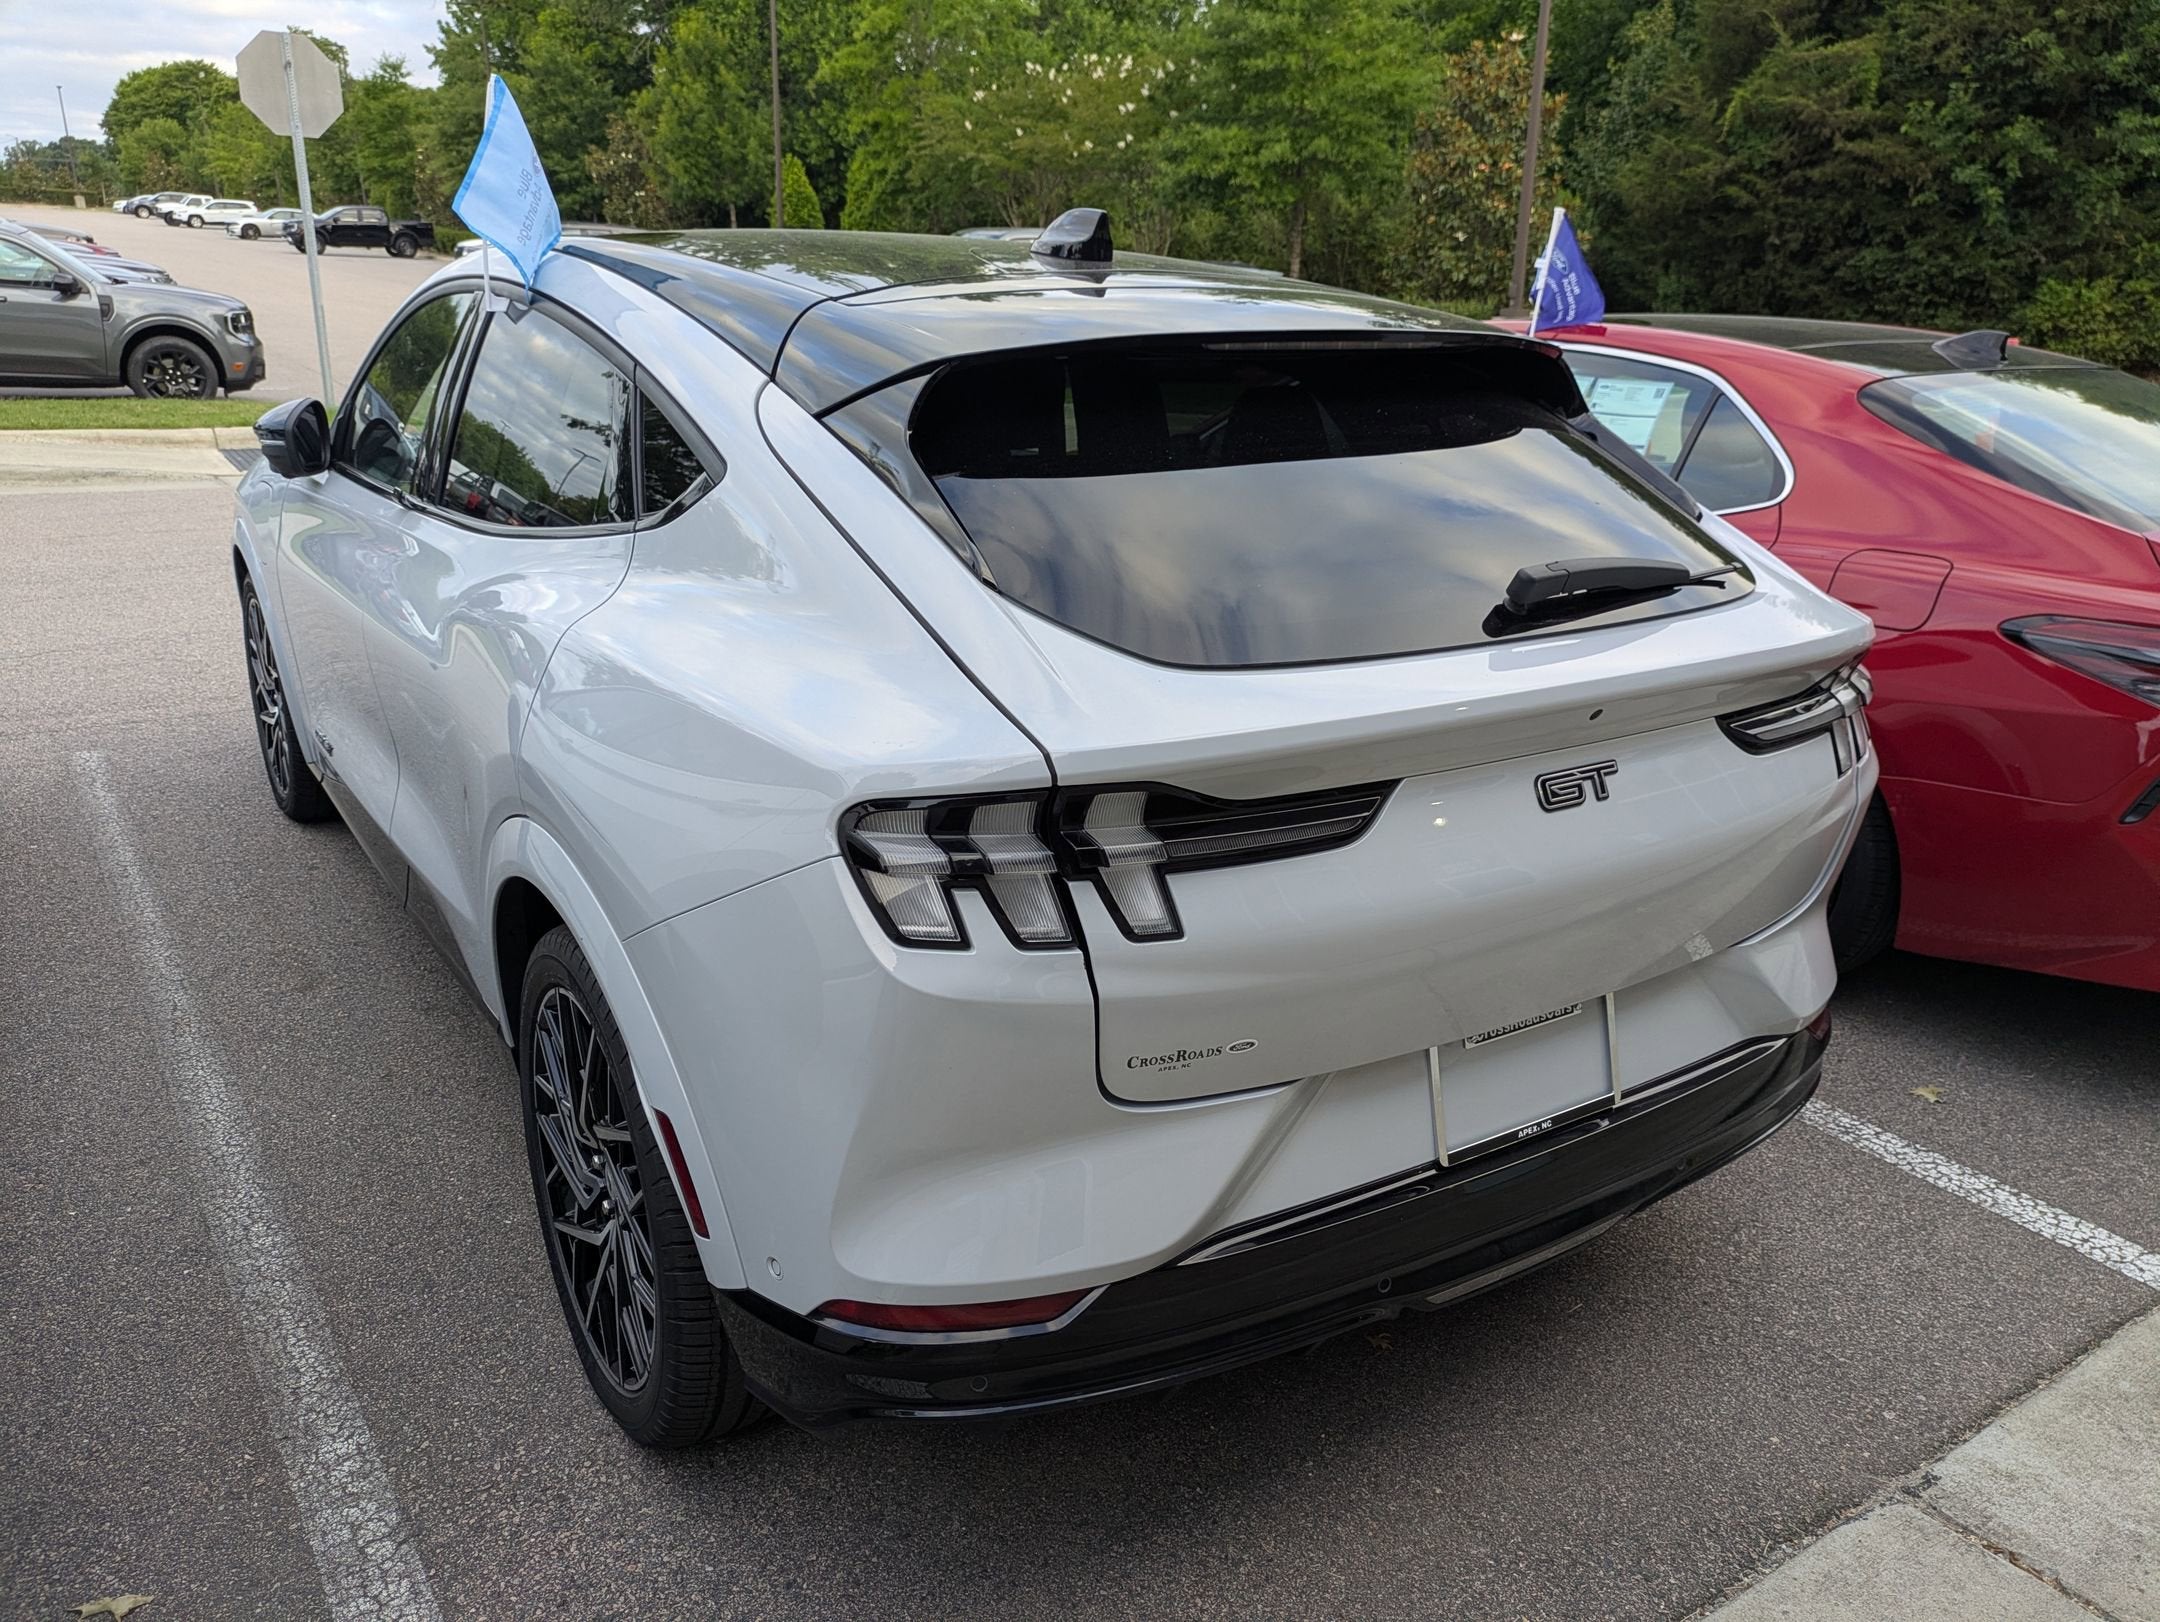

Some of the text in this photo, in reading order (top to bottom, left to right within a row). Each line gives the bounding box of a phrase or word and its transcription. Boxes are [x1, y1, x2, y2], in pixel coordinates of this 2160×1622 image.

[1534, 759, 1619, 813] GT
[1518, 1120, 1552, 1138] APEX, NC
